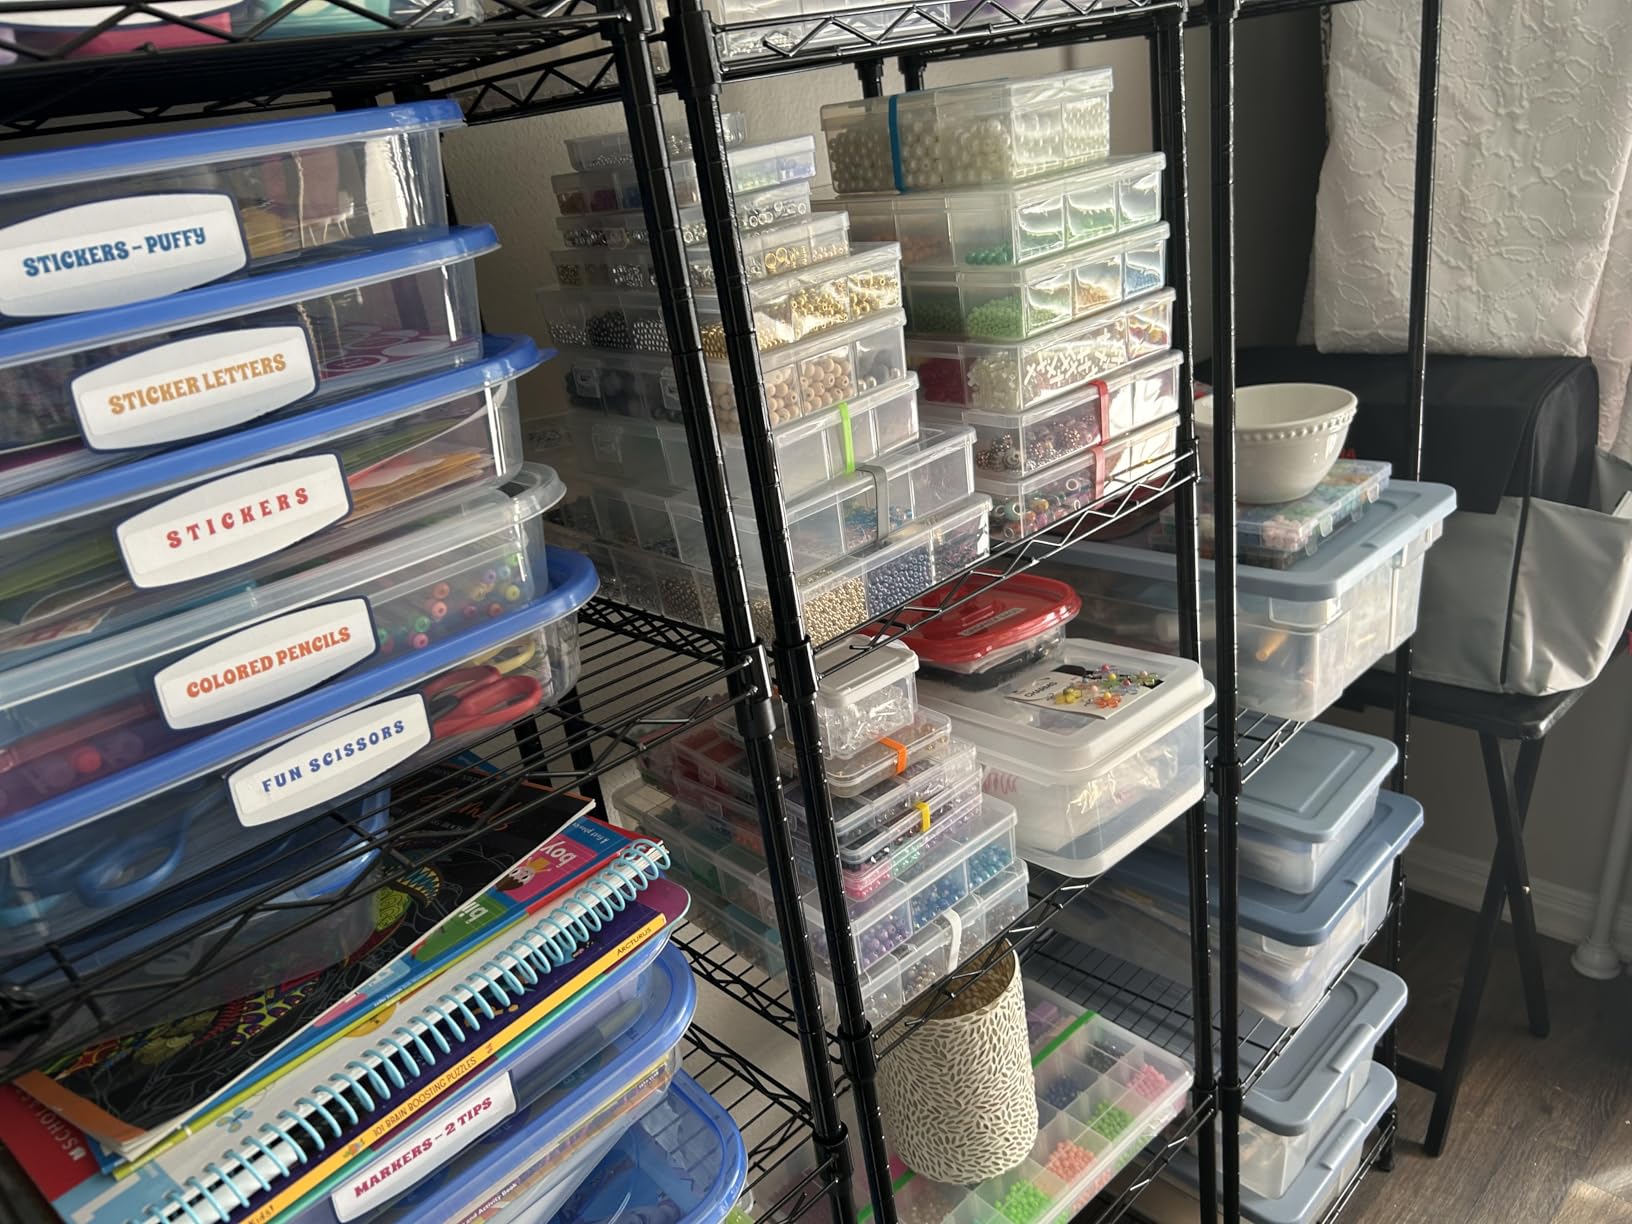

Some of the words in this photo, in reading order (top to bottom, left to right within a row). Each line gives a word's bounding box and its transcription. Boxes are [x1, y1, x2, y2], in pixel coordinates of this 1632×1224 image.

[23, 242, 130, 277] STICKERS
[145, 227, 207, 255] PUFFY
[108, 371, 201, 415] STICKER
[201, 353, 287, 391] LETTERS
[166, 487, 310, 549] STICKERS
[186, 655, 274, 699] COLORED
[275, 626, 352, 667] PENCILS
[262, 766, 304, 793] FUN
[308, 719, 406, 773] SCISSORS
[540, 840, 577, 868] boy
[373, 1126, 386, 1138] 101
[386, 1107, 408, 1128] BRAIN
[408, 1079, 447, 1111] BOOSTING
[447, 1056, 477, 1081] PUZZLES
[617, 927, 652, 957] ARCTURUS
[353, 1138, 433, 1197] MARKERS
[444, 1122, 456, 1136] 2
[457, 1097, 493, 1127] TIPS
[478, 1195, 502, 1215] Activity
[501, 1183, 518, 1197] Book
